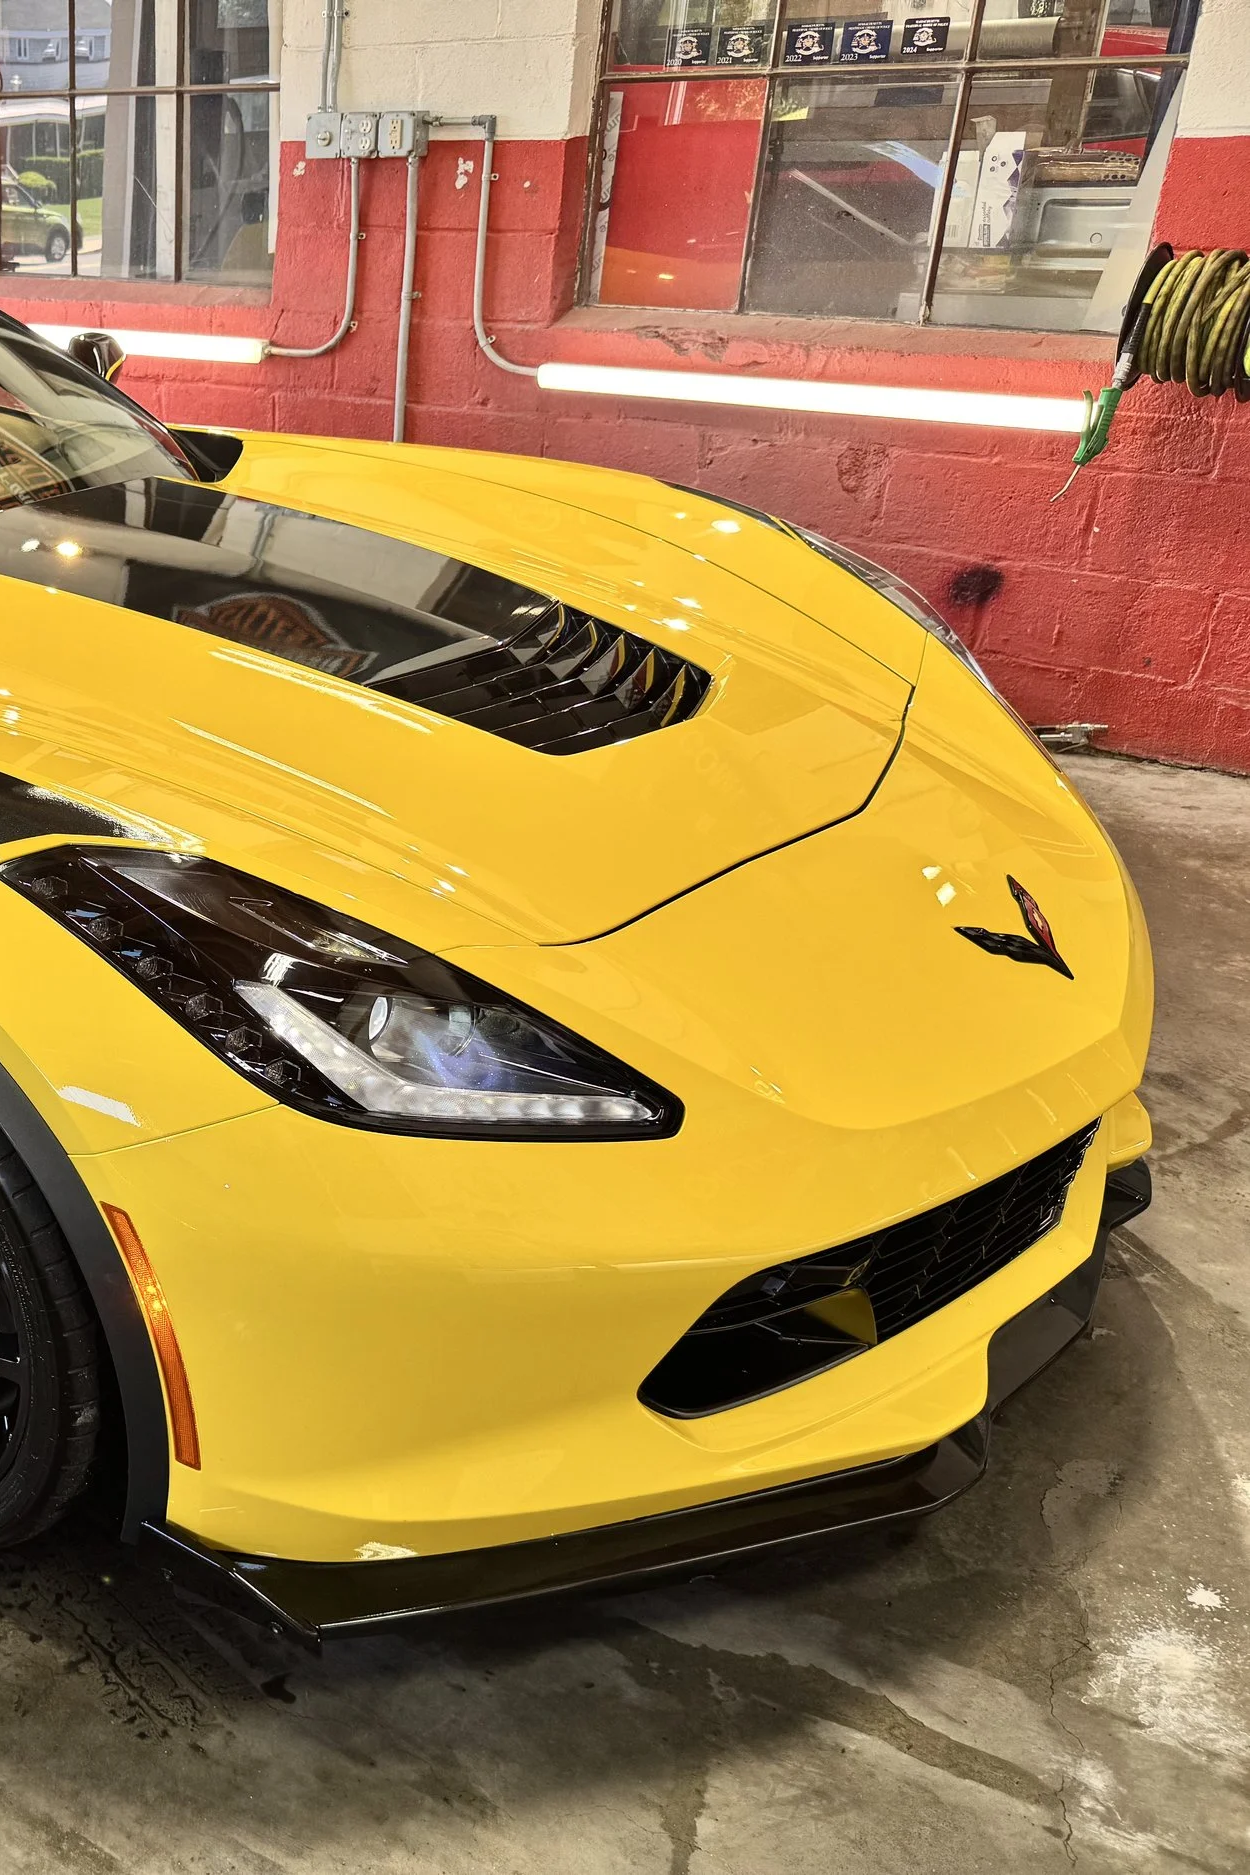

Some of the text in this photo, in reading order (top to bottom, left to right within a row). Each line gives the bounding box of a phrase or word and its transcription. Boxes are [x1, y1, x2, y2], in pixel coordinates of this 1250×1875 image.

[902, 46, 918, 54] 2024
[716, 56, 733, 64] 2021
[784, 54, 802, 63] 2022
[840, 53, 858, 62] 2023
